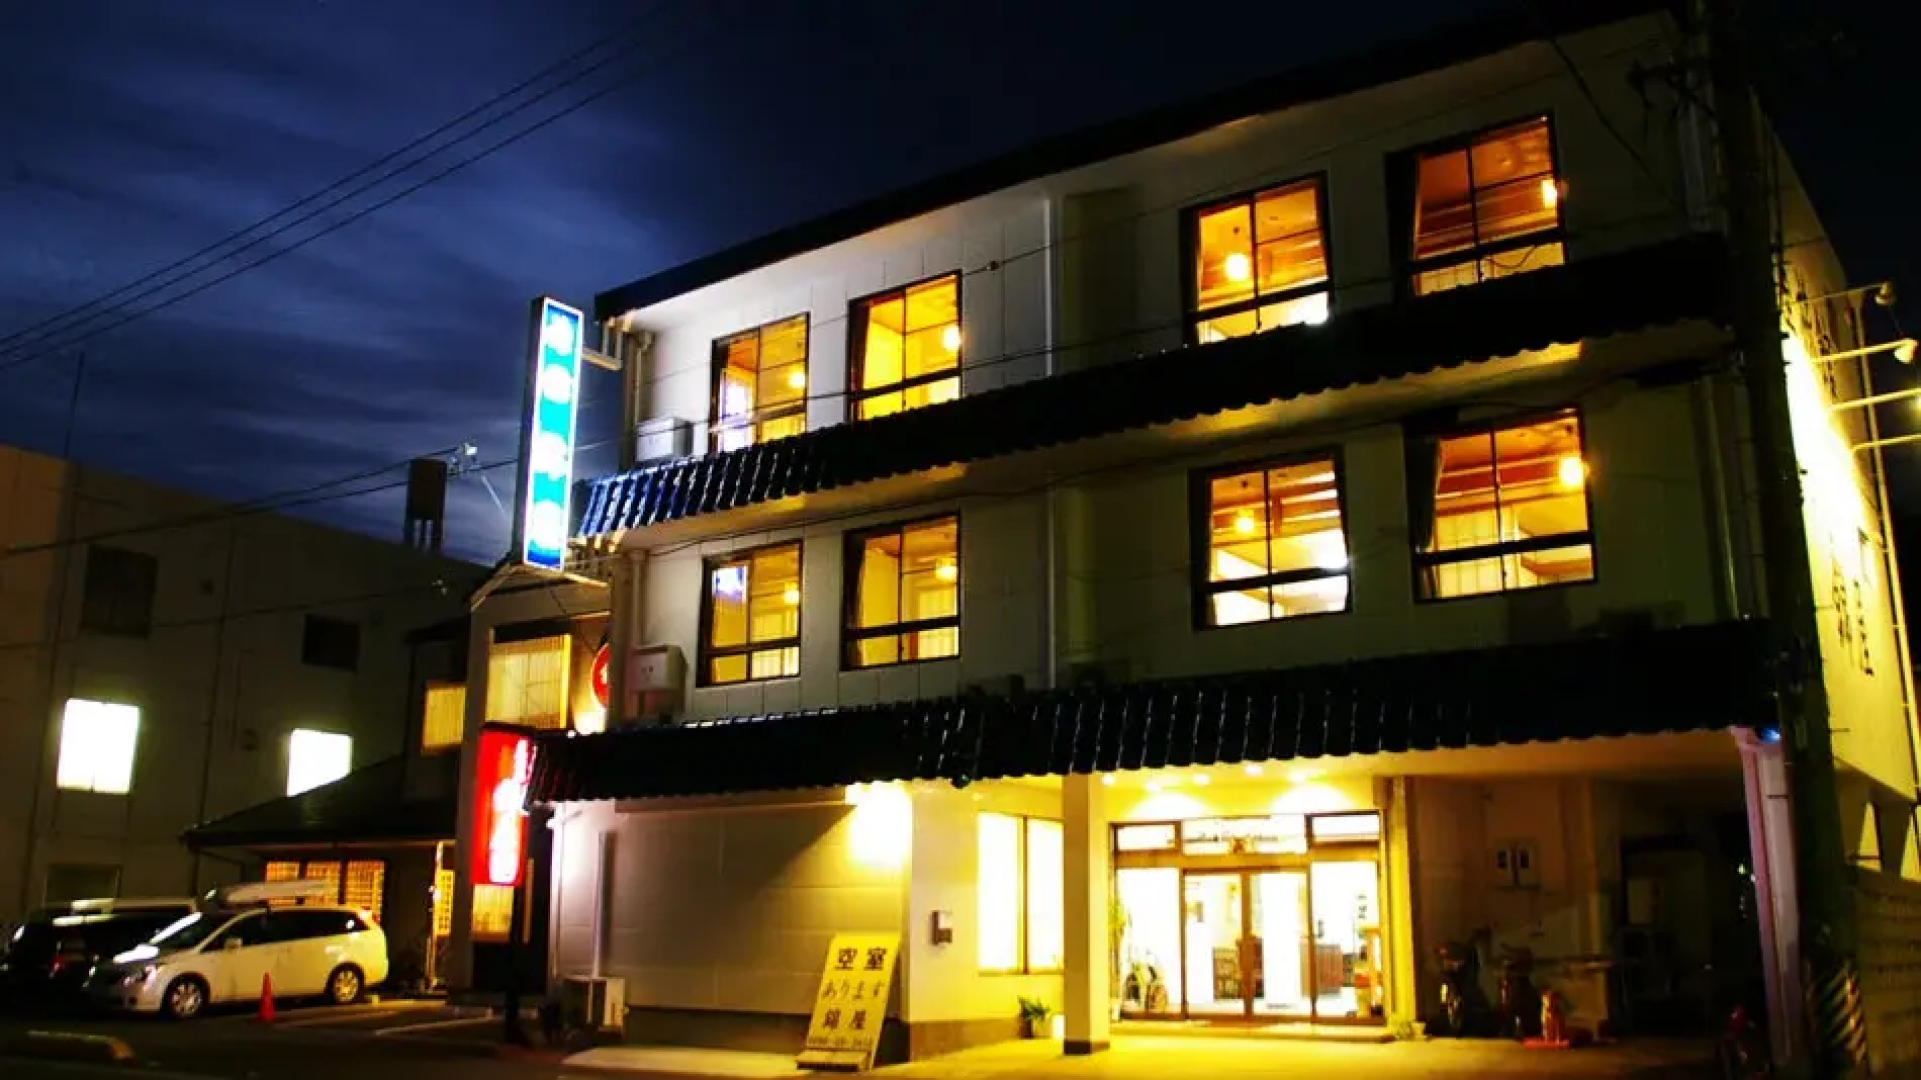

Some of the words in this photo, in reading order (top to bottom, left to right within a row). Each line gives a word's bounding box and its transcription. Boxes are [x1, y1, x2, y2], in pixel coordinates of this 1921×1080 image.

[834, 946, 888, 971] 空室
[822, 977, 886, 1000] あります
